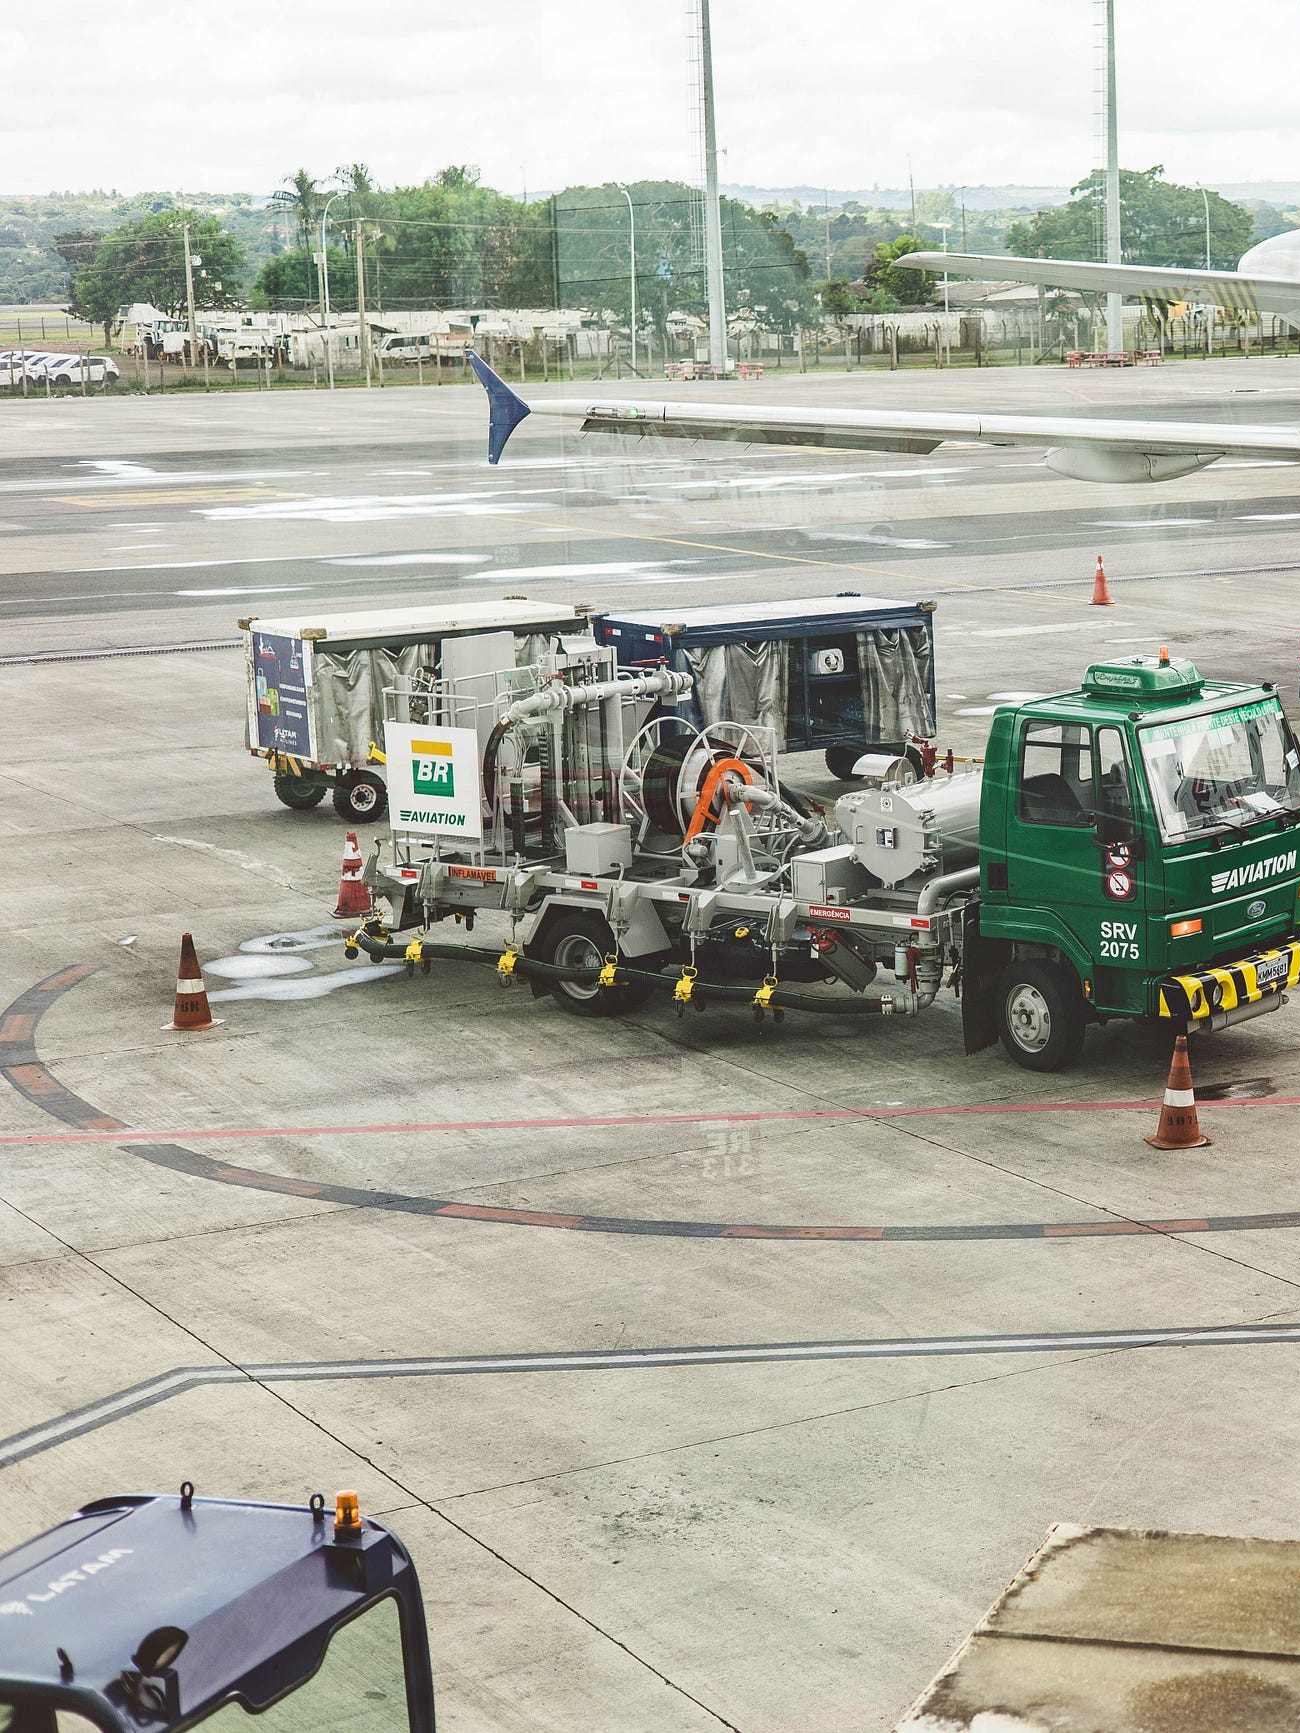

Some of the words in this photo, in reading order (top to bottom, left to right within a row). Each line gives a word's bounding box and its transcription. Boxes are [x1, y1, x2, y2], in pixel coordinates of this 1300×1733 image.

[417, 759, 449, 783] BR
[411, 811, 466, 826] AVIATION
[1226, 850, 1297, 890] AVIATION
[1100, 921, 1137, 940] SRV
[1100, 941, 1140, 960] 2075
[26, 1548, 134, 1602] LATAM
